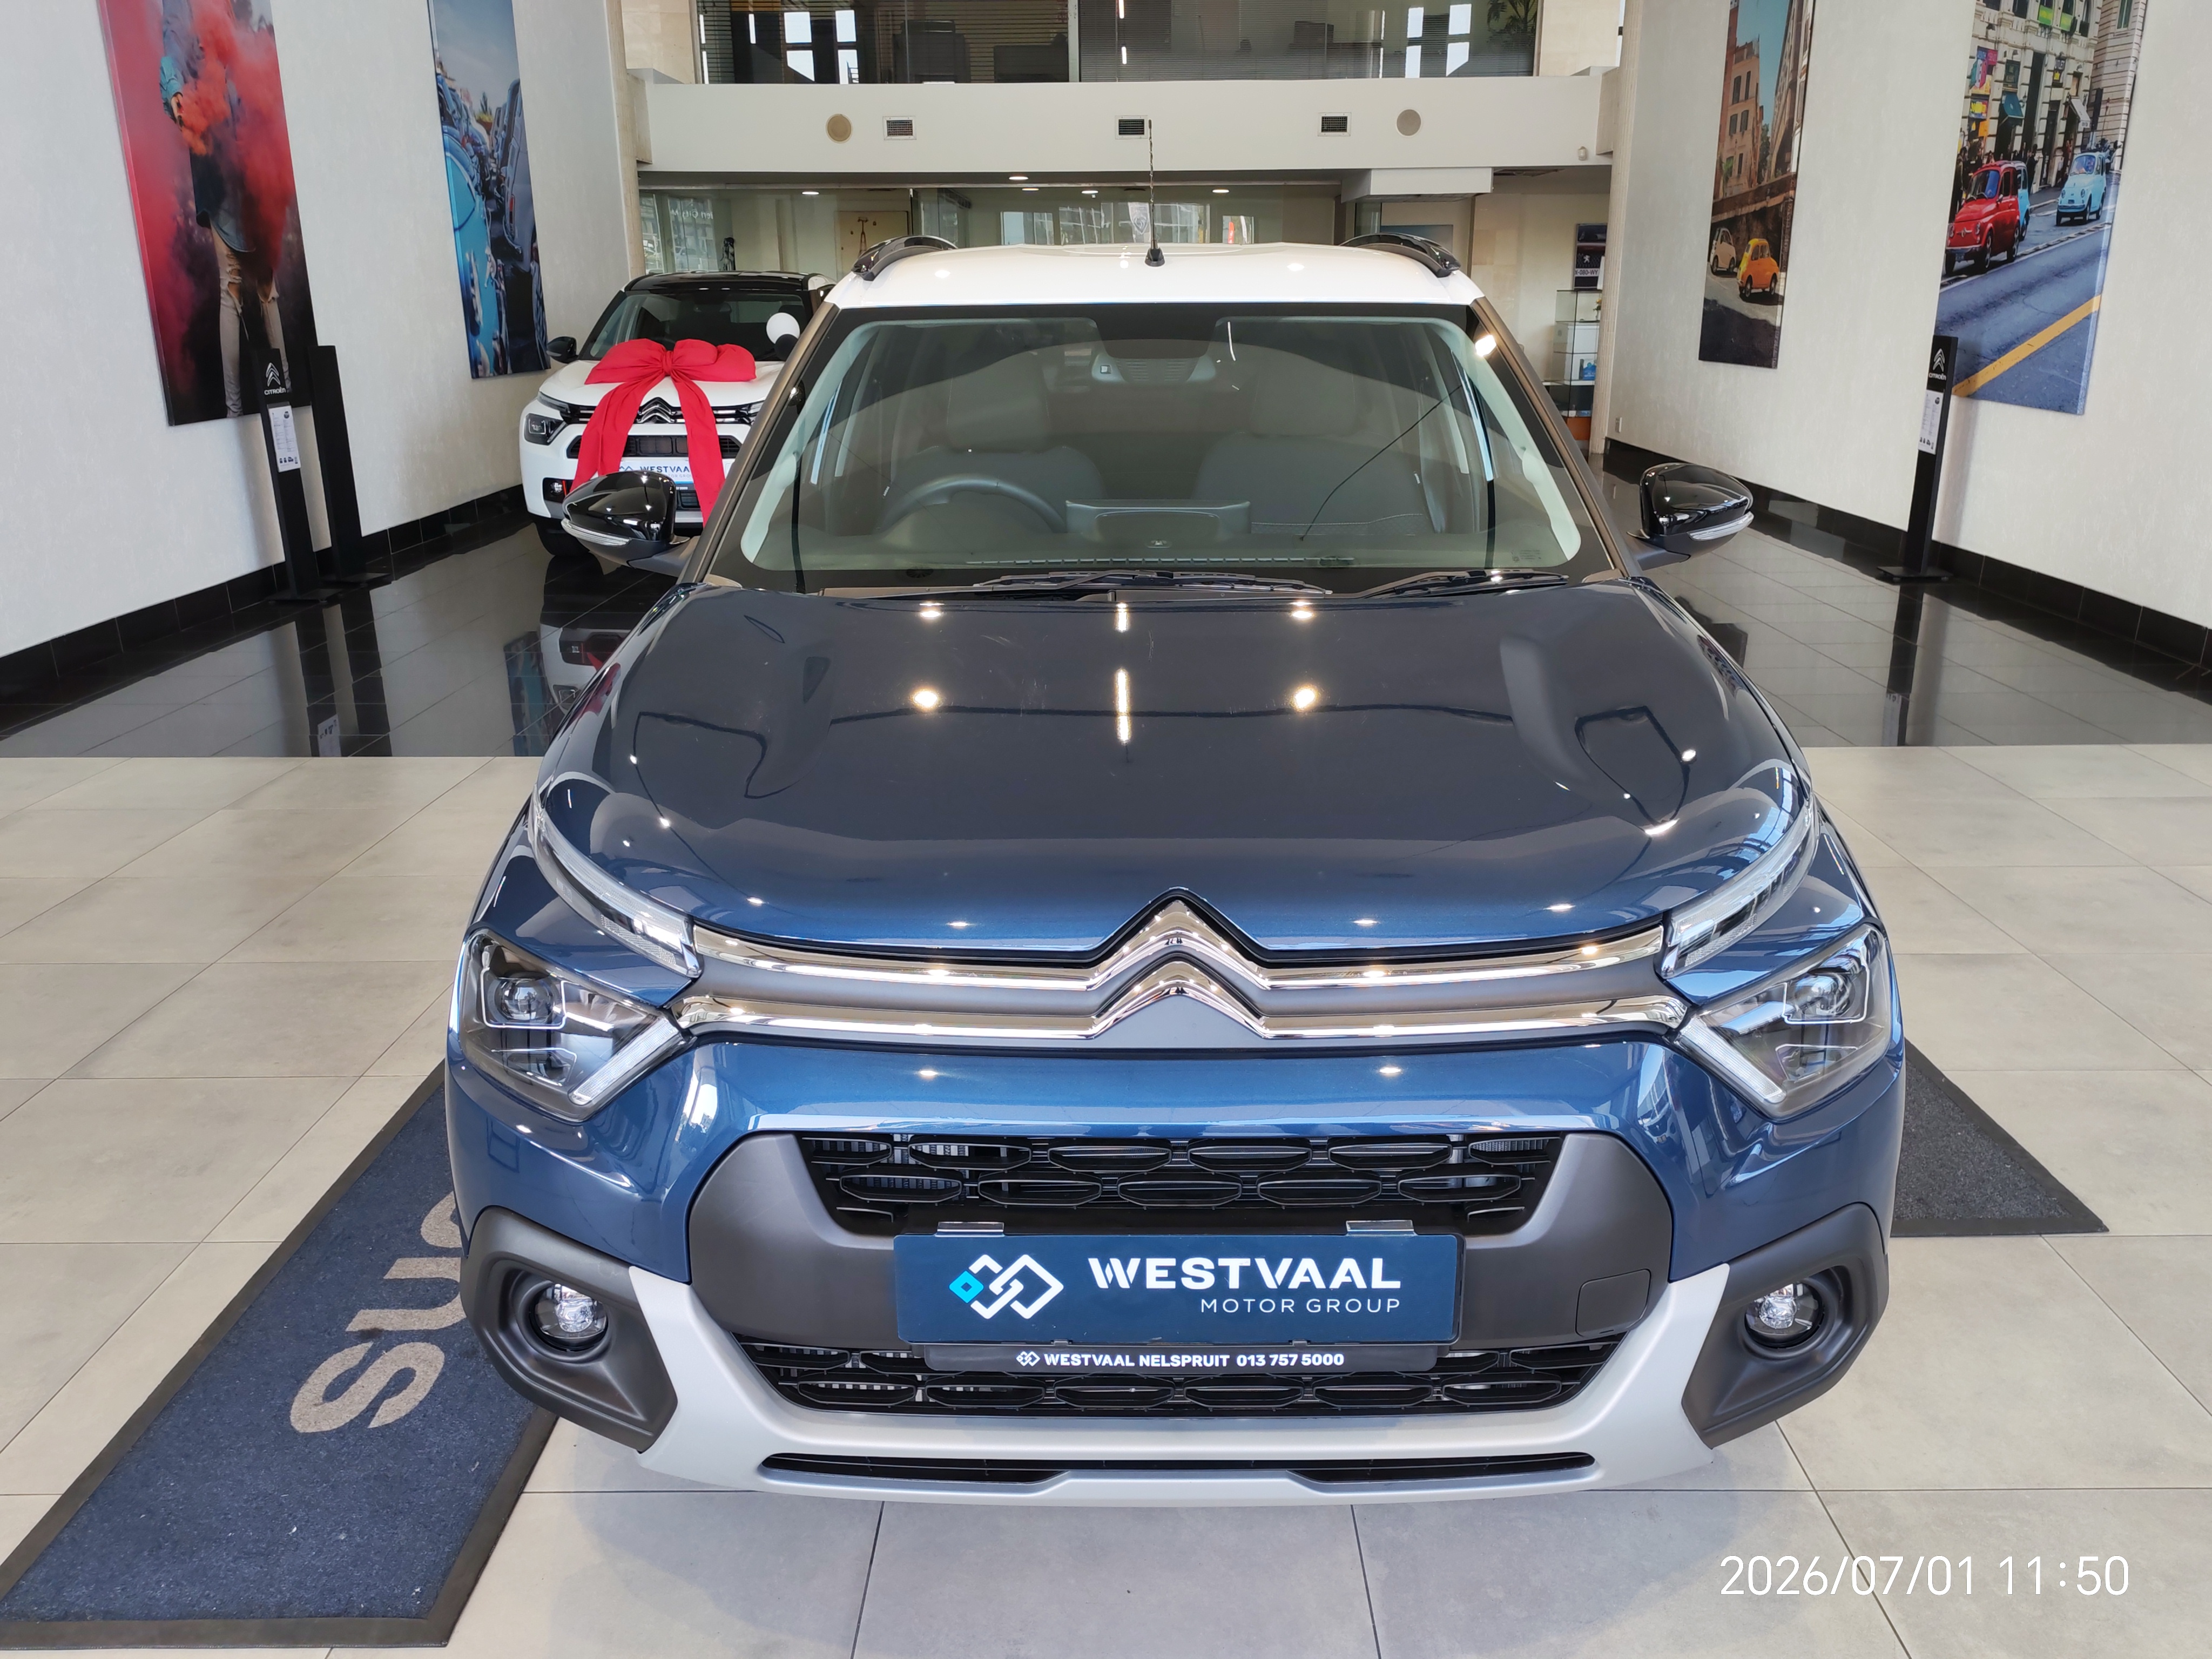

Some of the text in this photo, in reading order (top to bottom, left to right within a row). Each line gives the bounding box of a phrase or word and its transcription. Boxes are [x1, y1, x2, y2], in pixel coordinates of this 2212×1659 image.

[1088, 1257, 1401, 1290] WESTVAAL
[1202, 1298, 1400, 1313] MOTOR GROUP
[1043, 1353, 1344, 1367] WESTVAAL NELSPRUIT 013 757 5000
